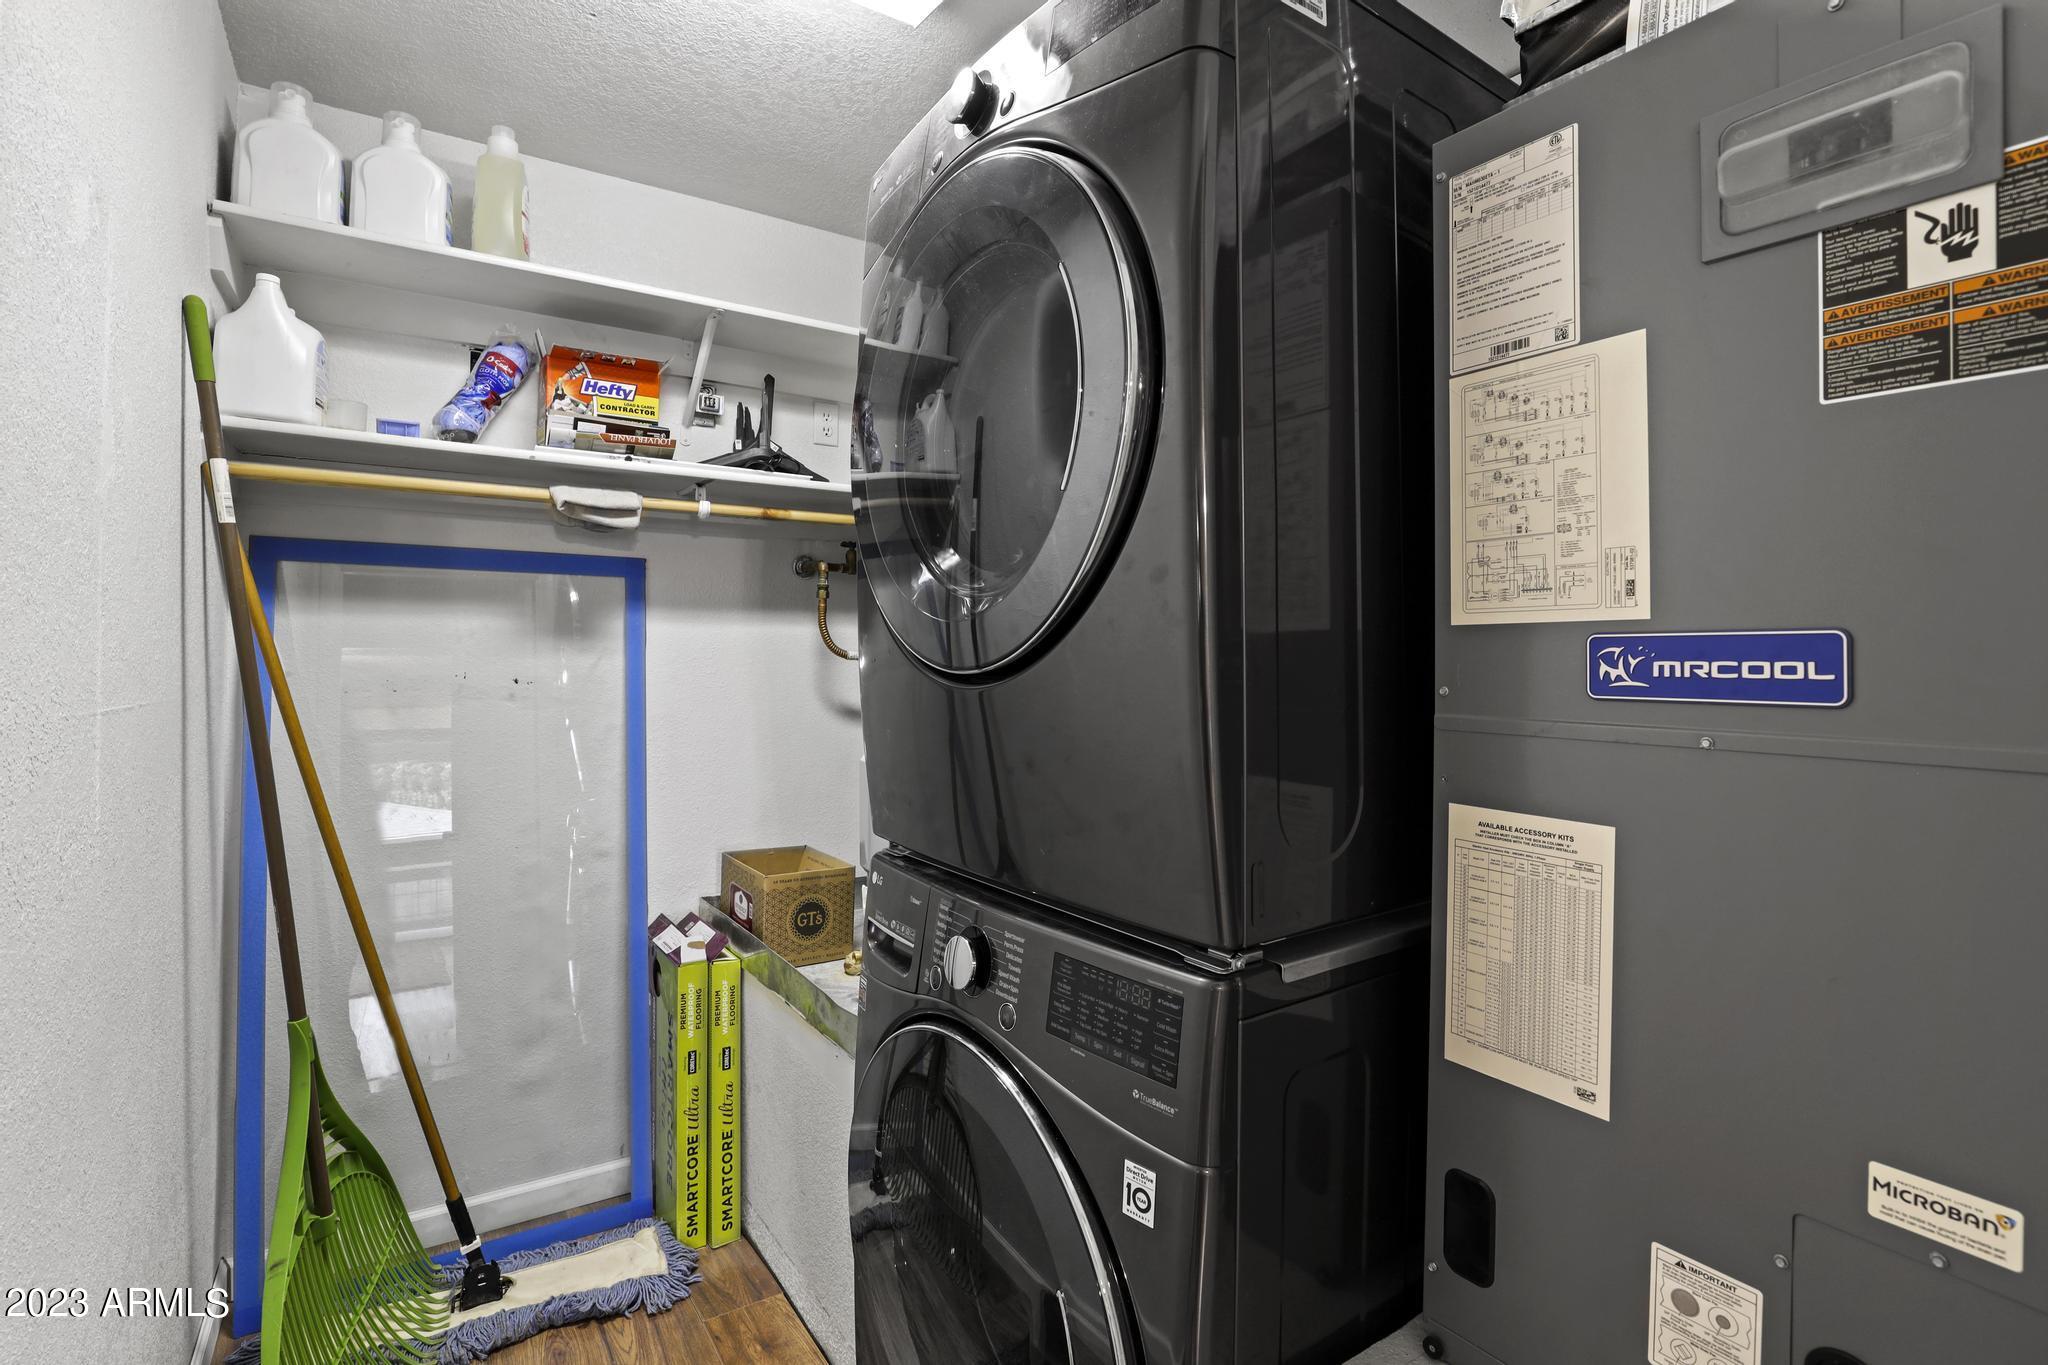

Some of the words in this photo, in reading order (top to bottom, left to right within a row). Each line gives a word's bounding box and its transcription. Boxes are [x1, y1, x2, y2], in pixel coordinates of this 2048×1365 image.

[1841, 286, 1947, 317] AVERTISSEMENT
[1840, 316, 1945, 345] AVERTISSEMENT
[584, 380, 633, 400] Hefty
[600, 404, 656, 416] CONTRACTOR
[609, 434, 639, 443] PANEL
[640, 436, 671, 446] LOUVER
[1652, 660, 1836, 681] MRCOOL
[1478, 821, 1513, 833] AVAILABLE
[1514, 827, 1556, 840] ACCESSORY
[1558, 834, 1575, 843] KITS
[798, 910, 822, 927] GT's
[722, 1130, 733, 1232] SMARTCORE
[1126, 1166, 1140, 1178] Direct
[1140, 1172, 1153, 1184] Drive
[687, 1134, 699, 1238] SMARTCORE
[1126, 1182, 1152, 1214] 10
[1137, 1196, 1147, 1205] YEAR
[1872, 1176, 2000, 1236] MICROBAN
[1688, 1265, 1737, 1293] IMPORTANT
